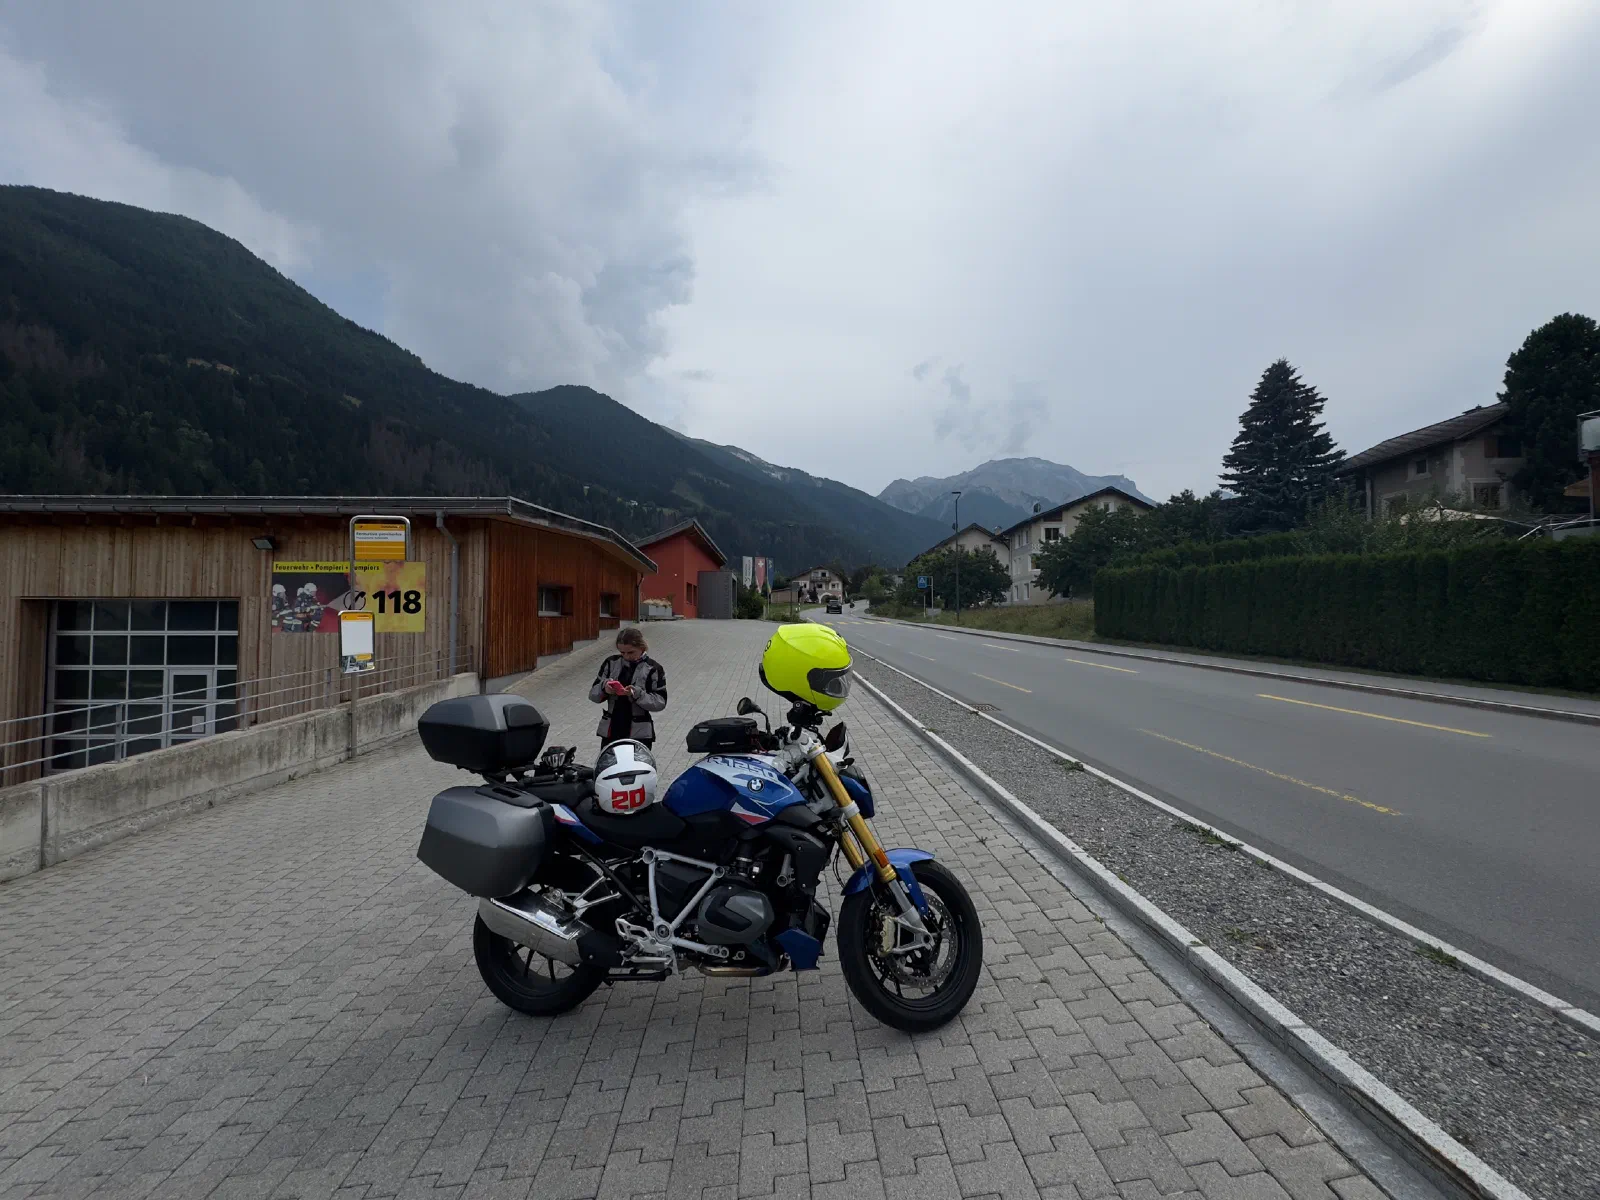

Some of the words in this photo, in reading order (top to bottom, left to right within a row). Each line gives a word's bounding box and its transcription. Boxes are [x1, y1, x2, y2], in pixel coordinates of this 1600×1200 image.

[275, 563, 309, 571] Feuerwehr
[315, 563, 344, 572] Pompieri
[372, 589, 422, 614] 118
[612, 784, 646, 809] 20
